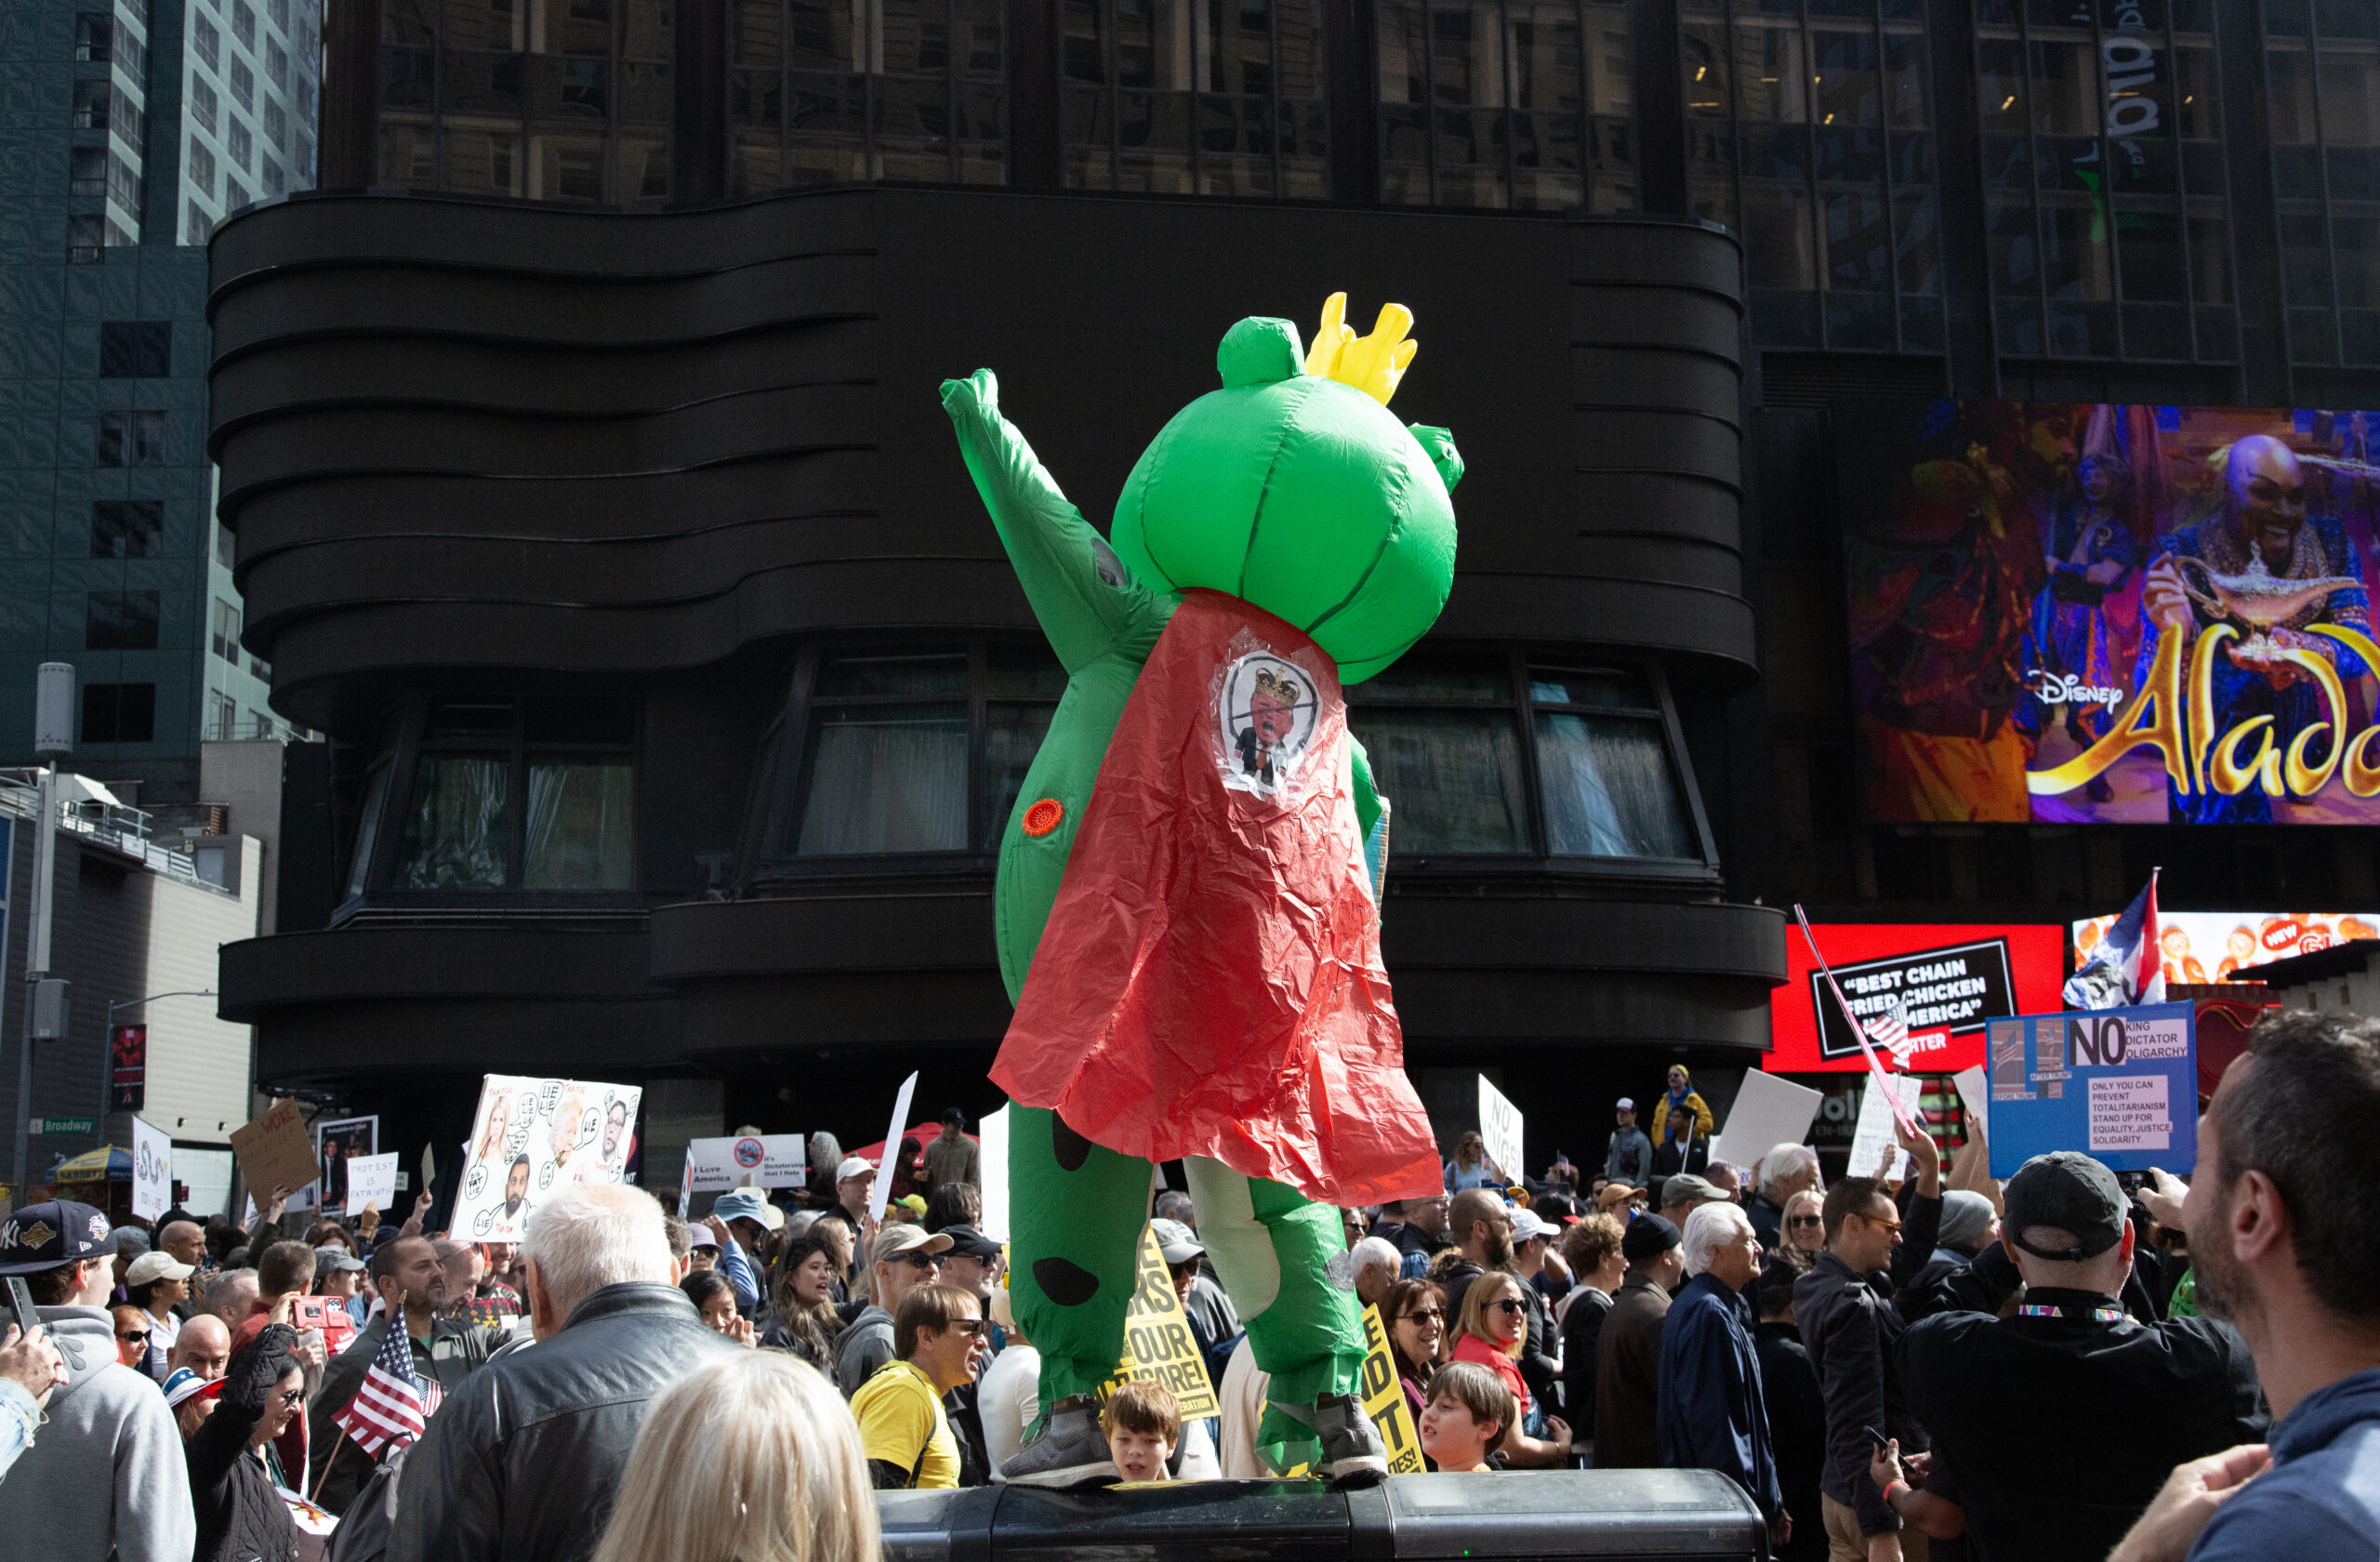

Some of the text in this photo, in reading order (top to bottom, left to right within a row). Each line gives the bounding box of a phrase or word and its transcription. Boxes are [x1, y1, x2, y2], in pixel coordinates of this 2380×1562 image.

[2028, 669, 2122, 714] Disney
[2266, 924, 2297, 946] NEW
[1907, 959, 1967, 985] CHAIN
[1902, 977, 1987, 1007] CHICKEN
[1906, 999, 1983, 1027] MERICA”
[2126, 1021, 2150, 1032] KING
[2069, 1017, 2126, 1066] NO
[2126, 1033, 2177, 1045] DICTATOR
[2126, 1047, 2187, 1059] OLIGARCHY
[542, 1085, 559, 1098] LIE
[2093, 1082, 2114, 1091] ONLY
[2135, 1080, 2153, 1089] CAN
[522, 1097, 534, 1106] LIE
[2093, 1092, 2129, 1101] PREVENT
[522, 1106, 534, 1115] LIE
[540, 1101, 555, 1111] LIE
[2093, 1103, 2166, 1112] TOTALITARIANISM
[261, 1104, 295, 1132] WOKE
[1492, 1093, 1511, 1133] NO
[2093, 1113, 2152, 1122] STAND UP FOR
[45, 1119, 92, 1133] Broadway
[584, 1118, 597, 1133] LIE
[351, 1161, 394, 1173] PROTEST
[367, 1176, 376, 1186] IS
[469, 1177, 483, 1188] FAT
[350, 1187, 394, 1199] PATRIOTIC
[469, 1186, 481, 1196] LIE
[477, 1219, 491, 1228] LIE
[1129, 1323, 1195, 1364] OUR
